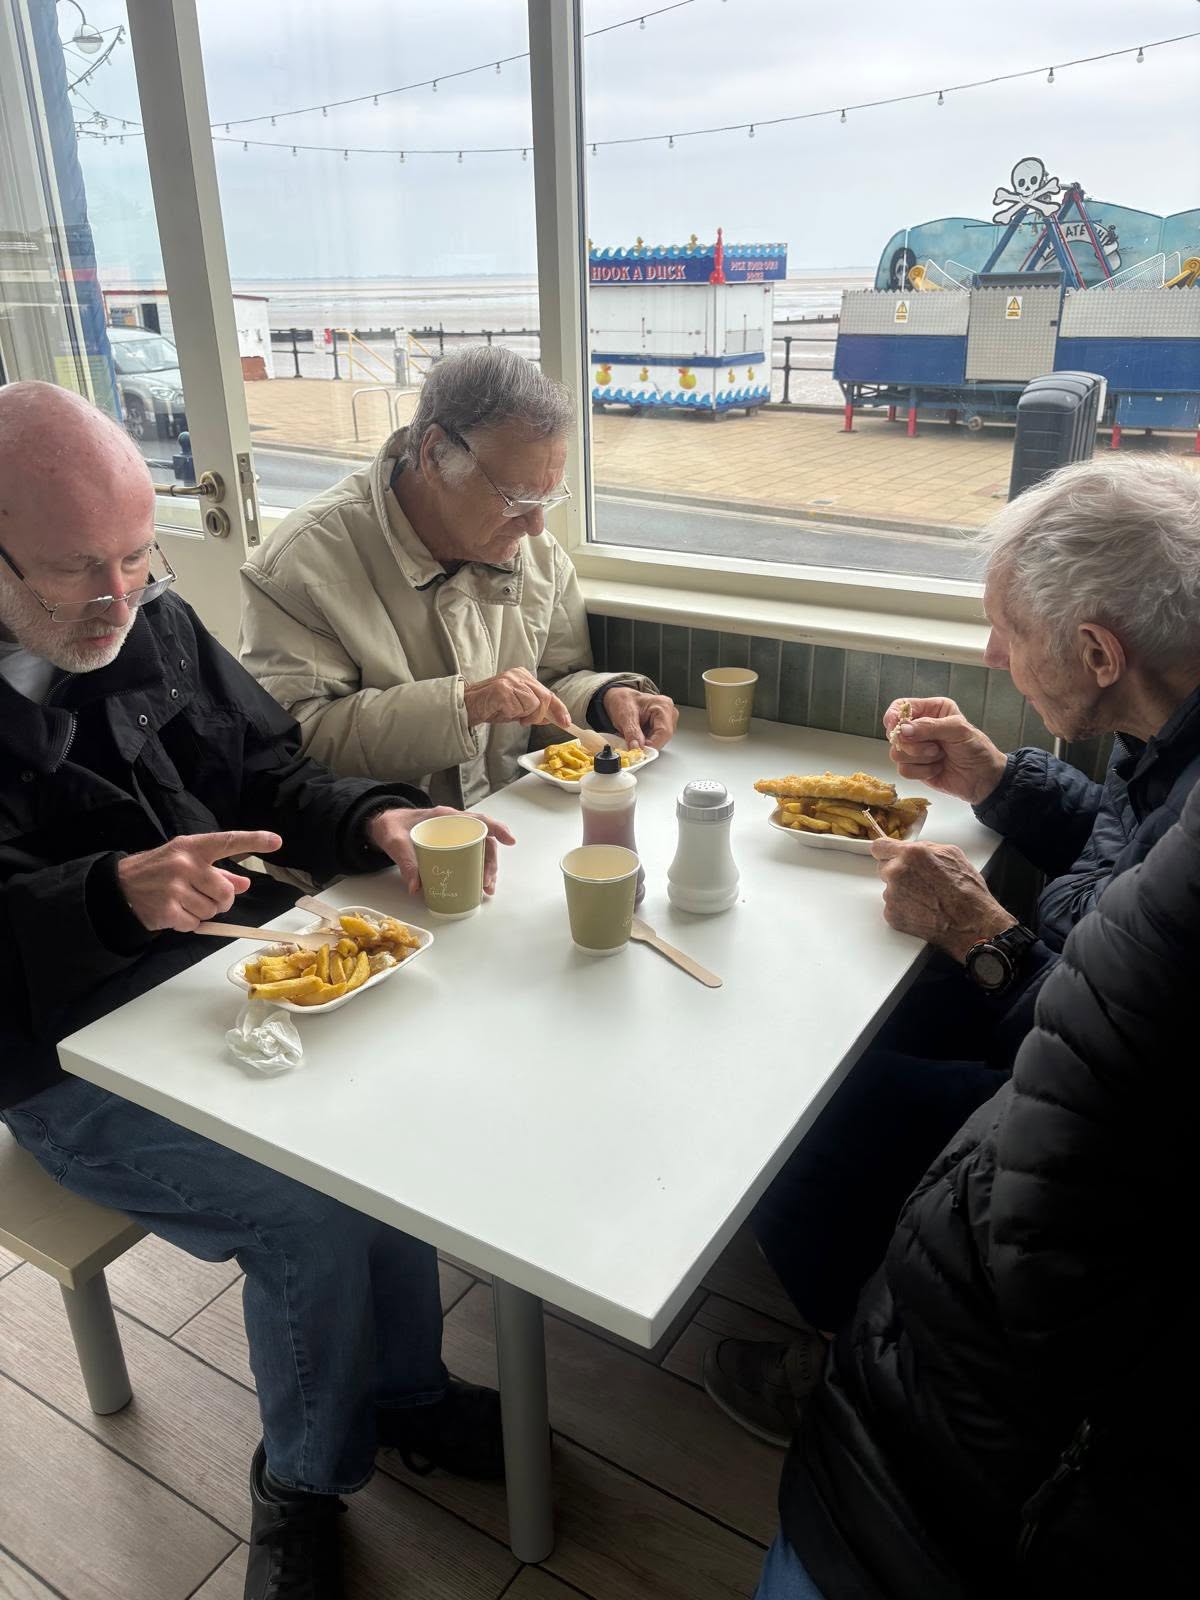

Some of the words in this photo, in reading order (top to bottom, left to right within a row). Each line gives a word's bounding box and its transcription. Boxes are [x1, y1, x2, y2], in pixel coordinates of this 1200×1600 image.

[591, 265, 630, 281] HOOK
[632, 265, 643, 281] A
[646, 264, 687, 280] DUCK
